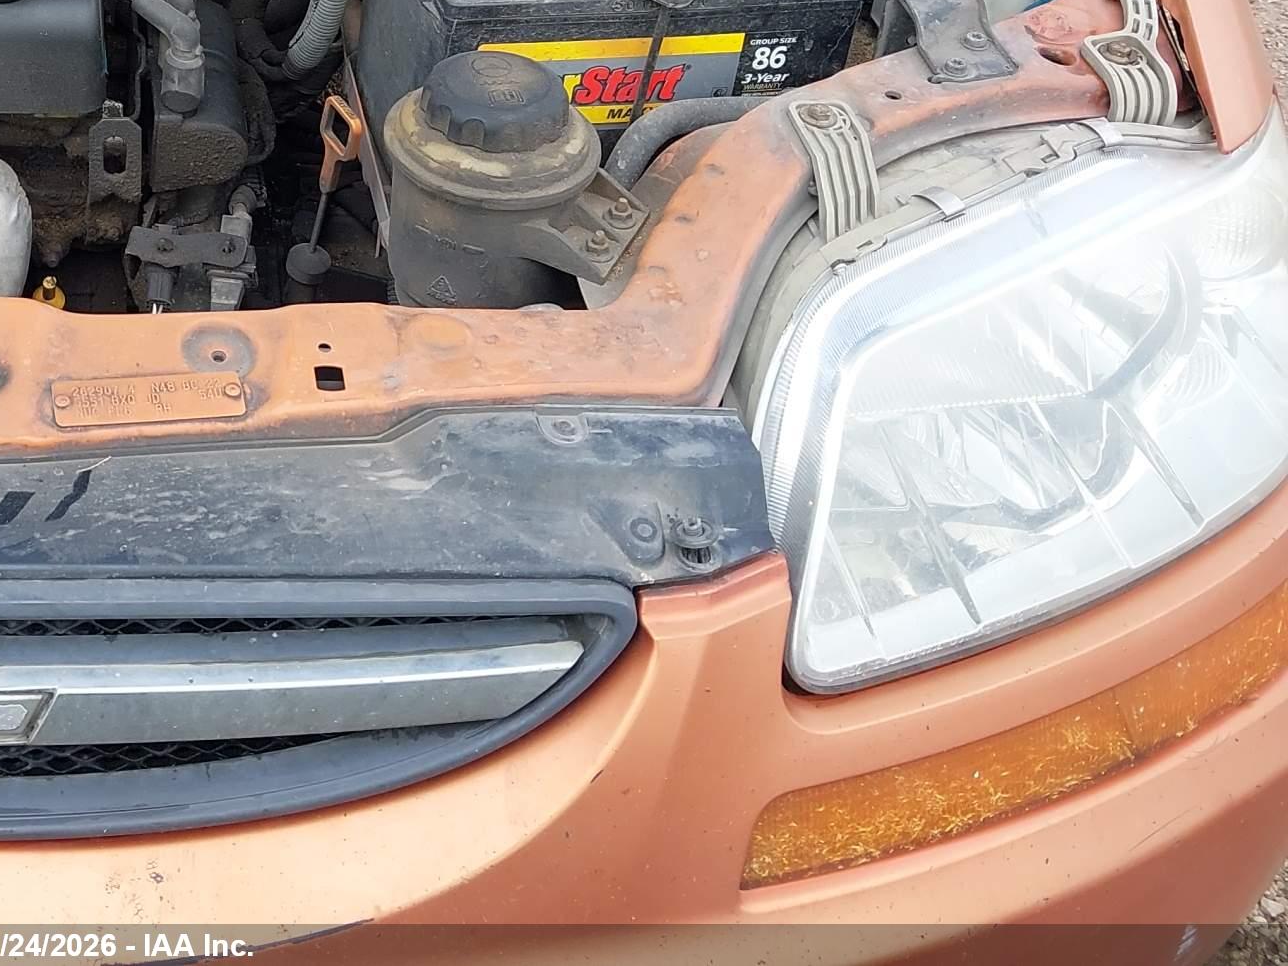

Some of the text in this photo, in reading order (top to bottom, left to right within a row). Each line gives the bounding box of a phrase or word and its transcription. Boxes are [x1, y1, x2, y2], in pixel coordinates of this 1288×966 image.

[749, 36, 798, 46] GROUP SIZE
[751, 45, 788, 71] 86
[740, 71, 790, 85] 3-Year
[742, 82, 783, 91] WARRANTY
